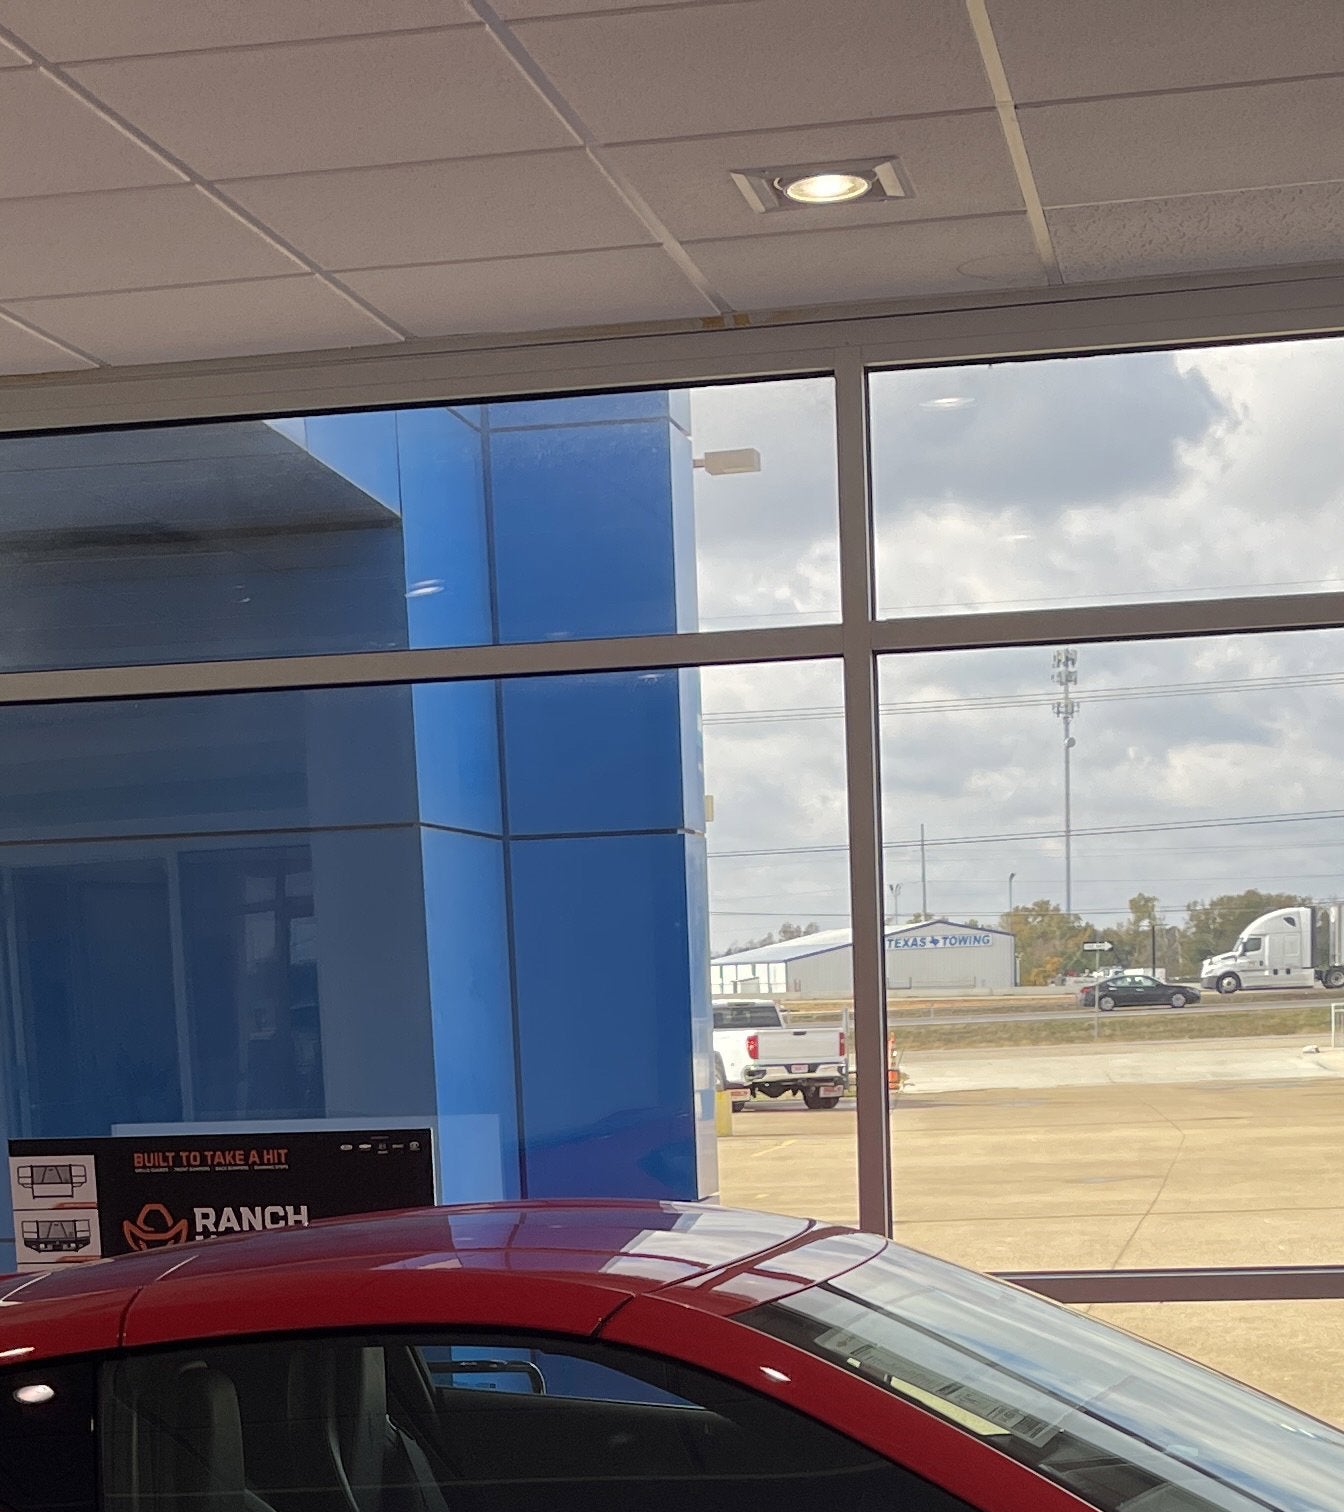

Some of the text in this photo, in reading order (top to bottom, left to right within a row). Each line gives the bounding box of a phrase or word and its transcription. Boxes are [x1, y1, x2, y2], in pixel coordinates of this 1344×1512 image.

[886, 934, 991, 949] TEXAS TOWING
[133, 1149, 289, 1167] BUILT TO TAKE A HIT
[193, 1205, 309, 1233] RANCH
